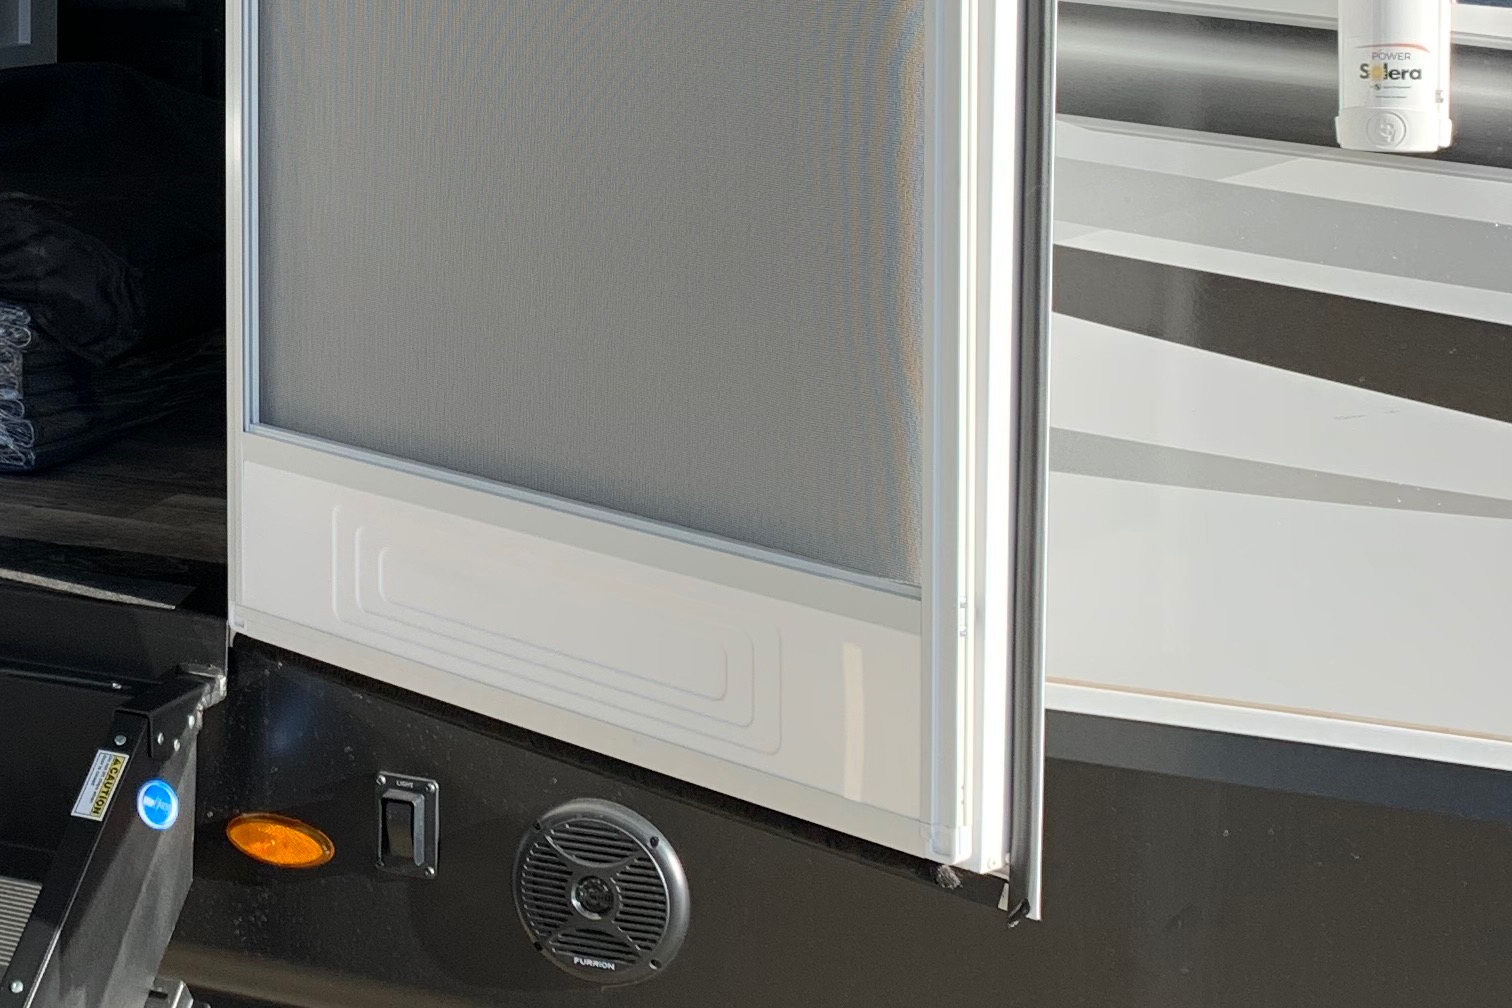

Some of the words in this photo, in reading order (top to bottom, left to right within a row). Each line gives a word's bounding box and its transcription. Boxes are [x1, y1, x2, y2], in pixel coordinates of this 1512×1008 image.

[1371, 51, 1411, 61] POWER
[1359, 61, 1422, 81] Solera
[92, 767, 119, 815] CAUTION
[396, 780, 414, 789] LIGHT
[573, 956, 615, 970] FURRION
